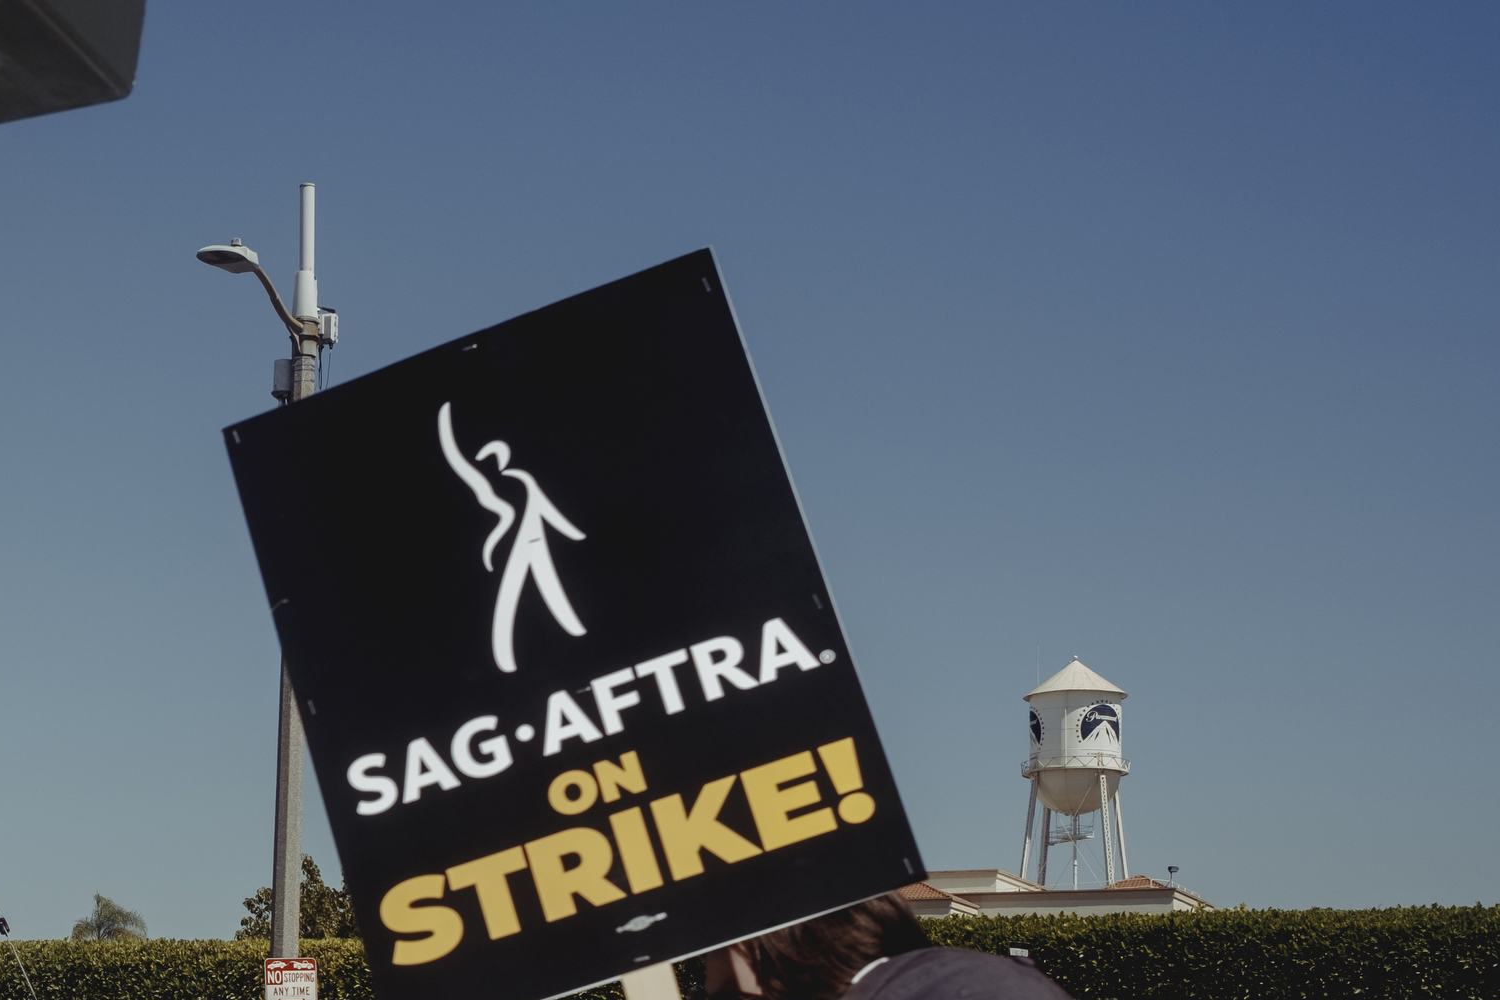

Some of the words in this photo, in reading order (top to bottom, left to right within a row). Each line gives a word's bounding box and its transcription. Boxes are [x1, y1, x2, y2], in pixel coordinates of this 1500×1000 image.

[547, 750, 648, 816] ON
[379, 737, 876, 966] STRIKE!
[267, 970, 282, 984] NO
[283, 972, 315, 983] STOPPING
[273, 986, 290, 996] ANY
[291, 986, 310, 997] TIME
